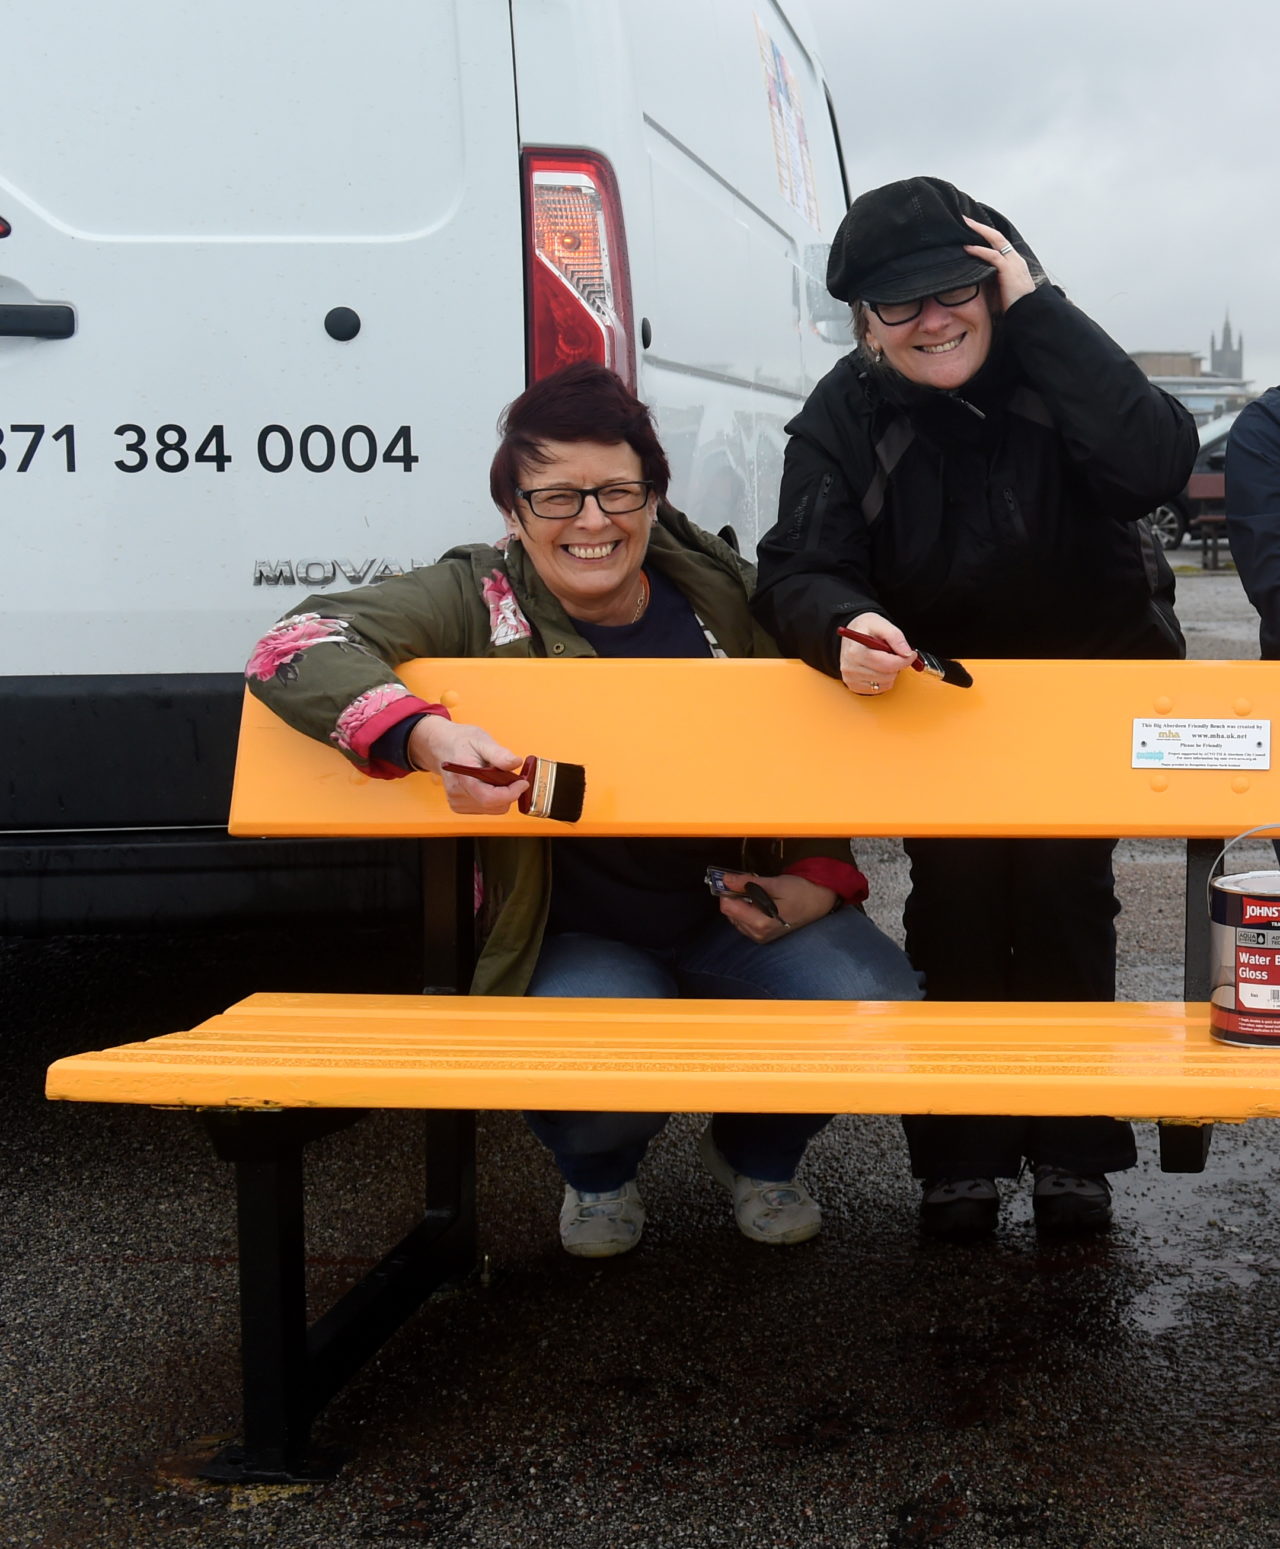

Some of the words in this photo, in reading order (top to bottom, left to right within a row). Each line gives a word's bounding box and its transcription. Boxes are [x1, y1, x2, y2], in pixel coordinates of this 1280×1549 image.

[0, 424, 77, 473] 71
[114, 424, 233, 473] 384
[257, 424, 419, 473] 0004
[1158, 729, 1181, 739] mha
[1191, 732, 1247, 740] www.mha.uk.net
[1239, 932, 1256, 940] AQUA
[1239, 951, 1272, 966] Water
[1239, 967, 1268, 980] Gloss
